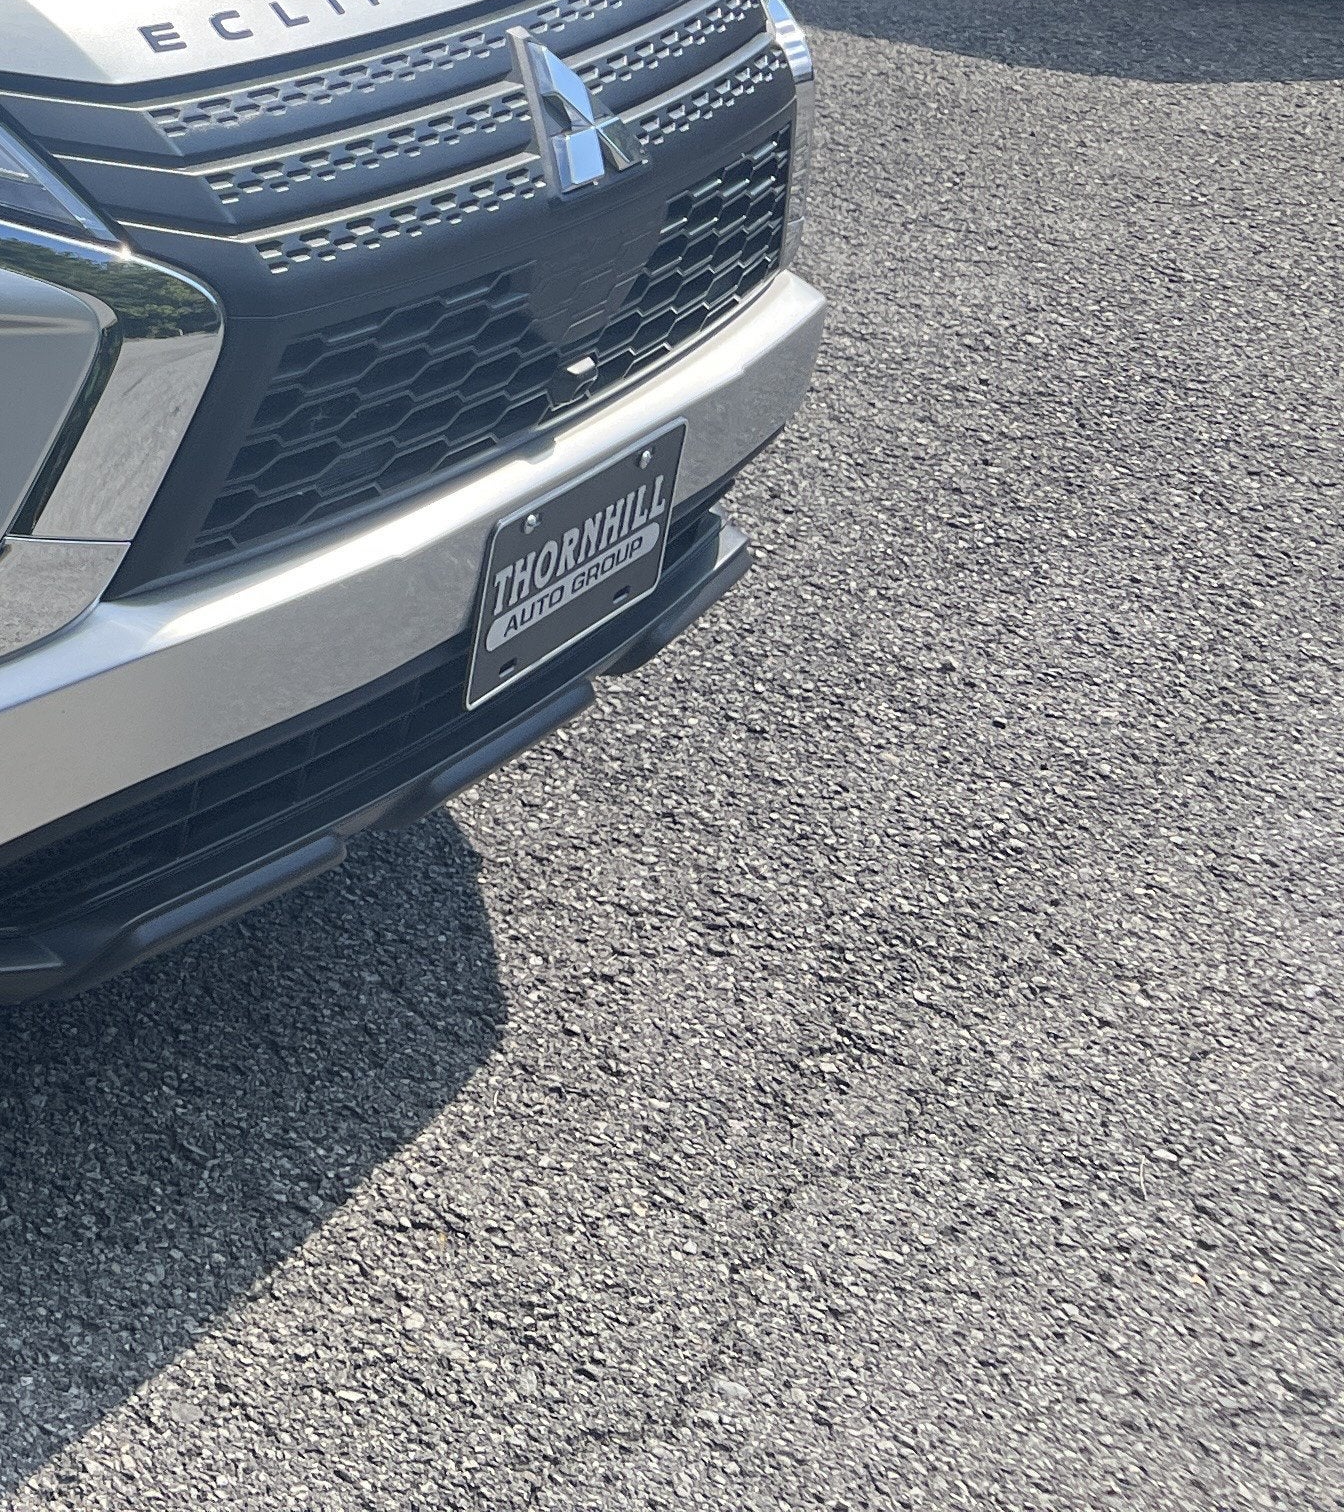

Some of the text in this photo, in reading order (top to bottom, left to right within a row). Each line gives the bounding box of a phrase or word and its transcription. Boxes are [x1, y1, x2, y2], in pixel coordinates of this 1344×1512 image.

[493, 474, 666, 616] THORNHILL
[503, 535, 643, 638] AUTO GROUP
